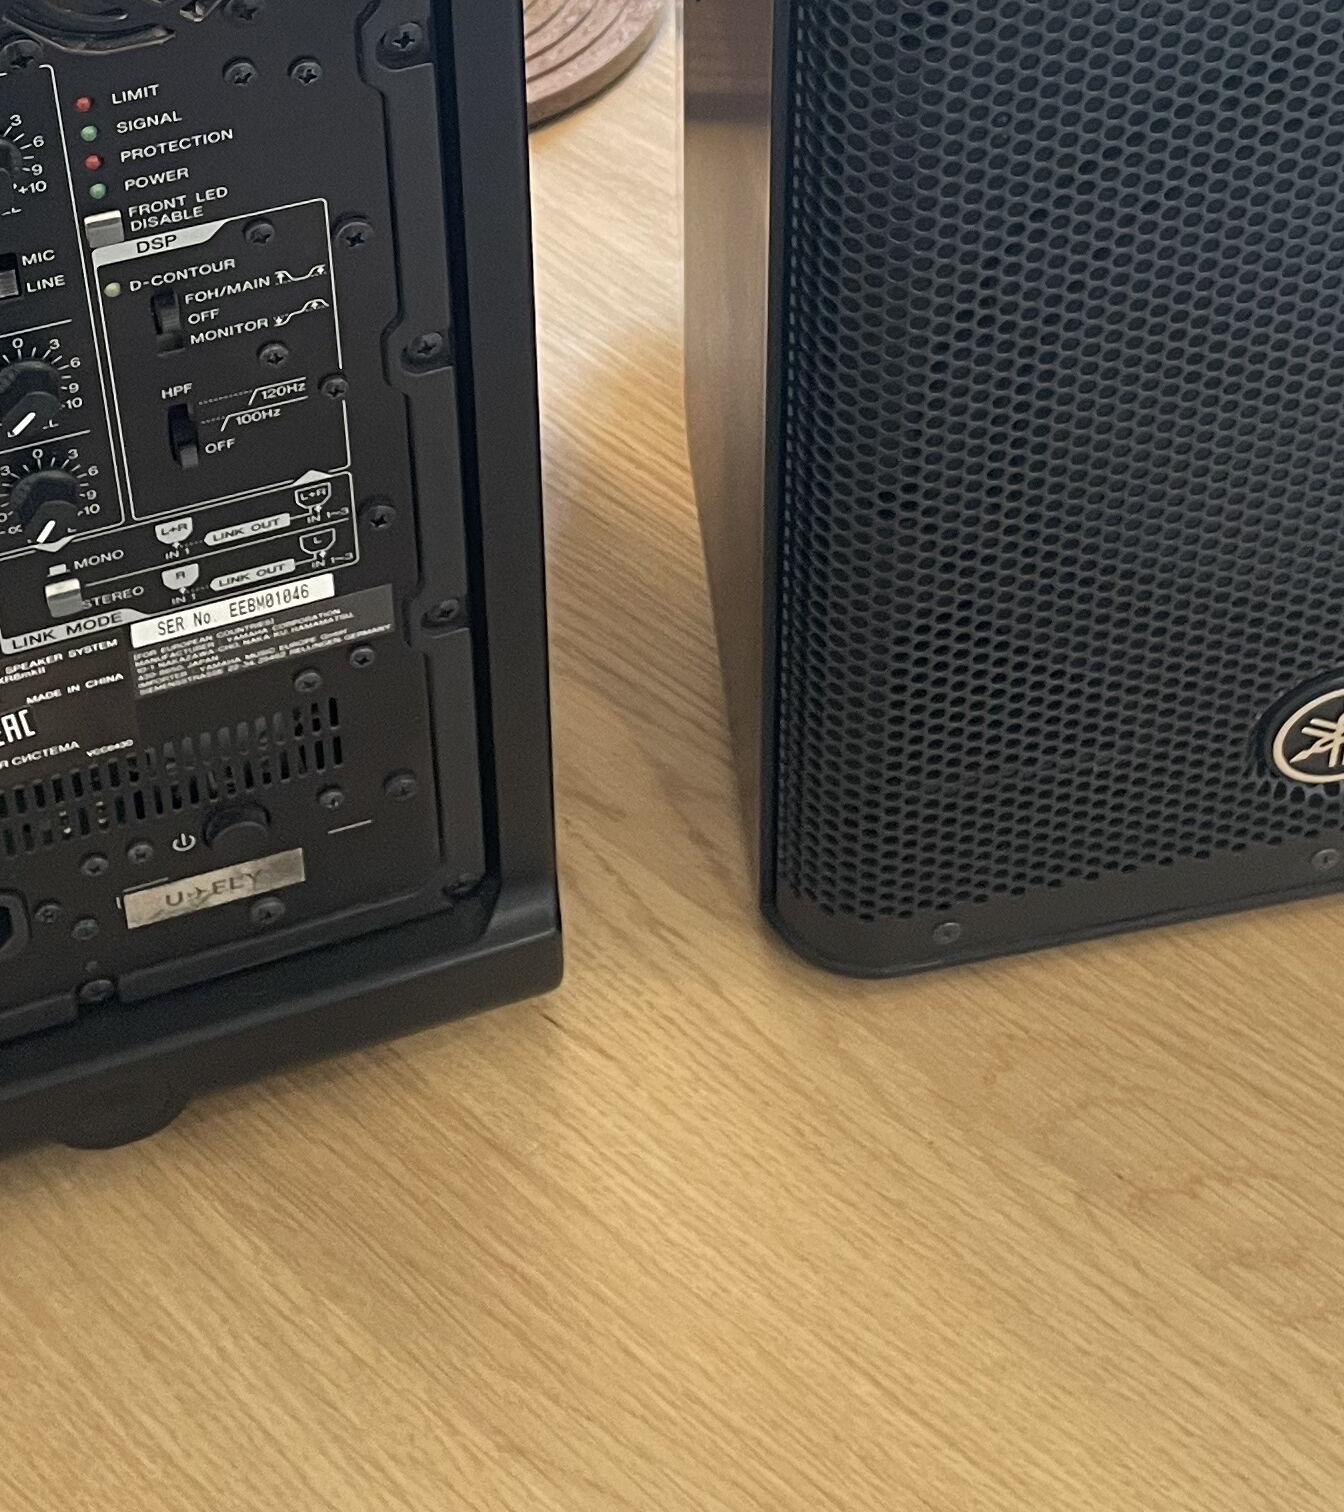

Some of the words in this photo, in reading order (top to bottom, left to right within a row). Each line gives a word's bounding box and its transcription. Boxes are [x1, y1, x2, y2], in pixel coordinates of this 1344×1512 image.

[111, 84, 159, 105] LIMIT
[9, 114, 22, 127] 3
[116, 110, 183, 134] SIGNAL
[32, 135, 45, 148] 6
[120, 128, 234, 163] PROTECTION
[124, 167, 190, 192] POWER
[128, 194, 187, 218] FRONT
[195, 186, 229, 204] LED
[130, 205, 204, 232] DISABLE
[136, 234, 177, 254] DSP
[21, 247, 57, 267] MIC
[25, 273, 66, 295] LINE
[129, 258, 236, 292] D-CONTOUR
[184, 275, 271, 305] FOH/MAIN
[187, 308, 220, 325] OFF
[190, 317, 269, 345] MONITOR
[11, 337, 24, 349] 0
[49, 338, 60, 351] 3
[69, 356, 81, 369] 6
[161, 382, 193, 400] HPF
[260, 382, 307, 400] 120Hz
[235, 408, 282, 426] 100Hz
[32, 448, 44, 460] 0
[67, 448, 79, 460] 3
[205, 438, 236, 455] OFF
[87, 465, 99, 477] 6
[212, 527, 245, 542] LINK
[250, 517, 281, 532] OUT
[73, 549, 125, 570] MONO
[164, 550, 179, 560] IN
[218, 572, 251, 588] LINK
[256, 563, 286, 578] OUT
[82, 586, 145, 610] STEREO
[11, 630, 57, 650] LINK
[66, 611, 124, 636] MODE
[157, 614, 185, 636] SER
[5, 652, 64, 674] SPEAKER
[68, 639, 118, 658] SYSTEM
[26, 688, 62, 705] MADE
[67, 683, 81, 694] IN
[85, 672, 124, 689] CHINA
